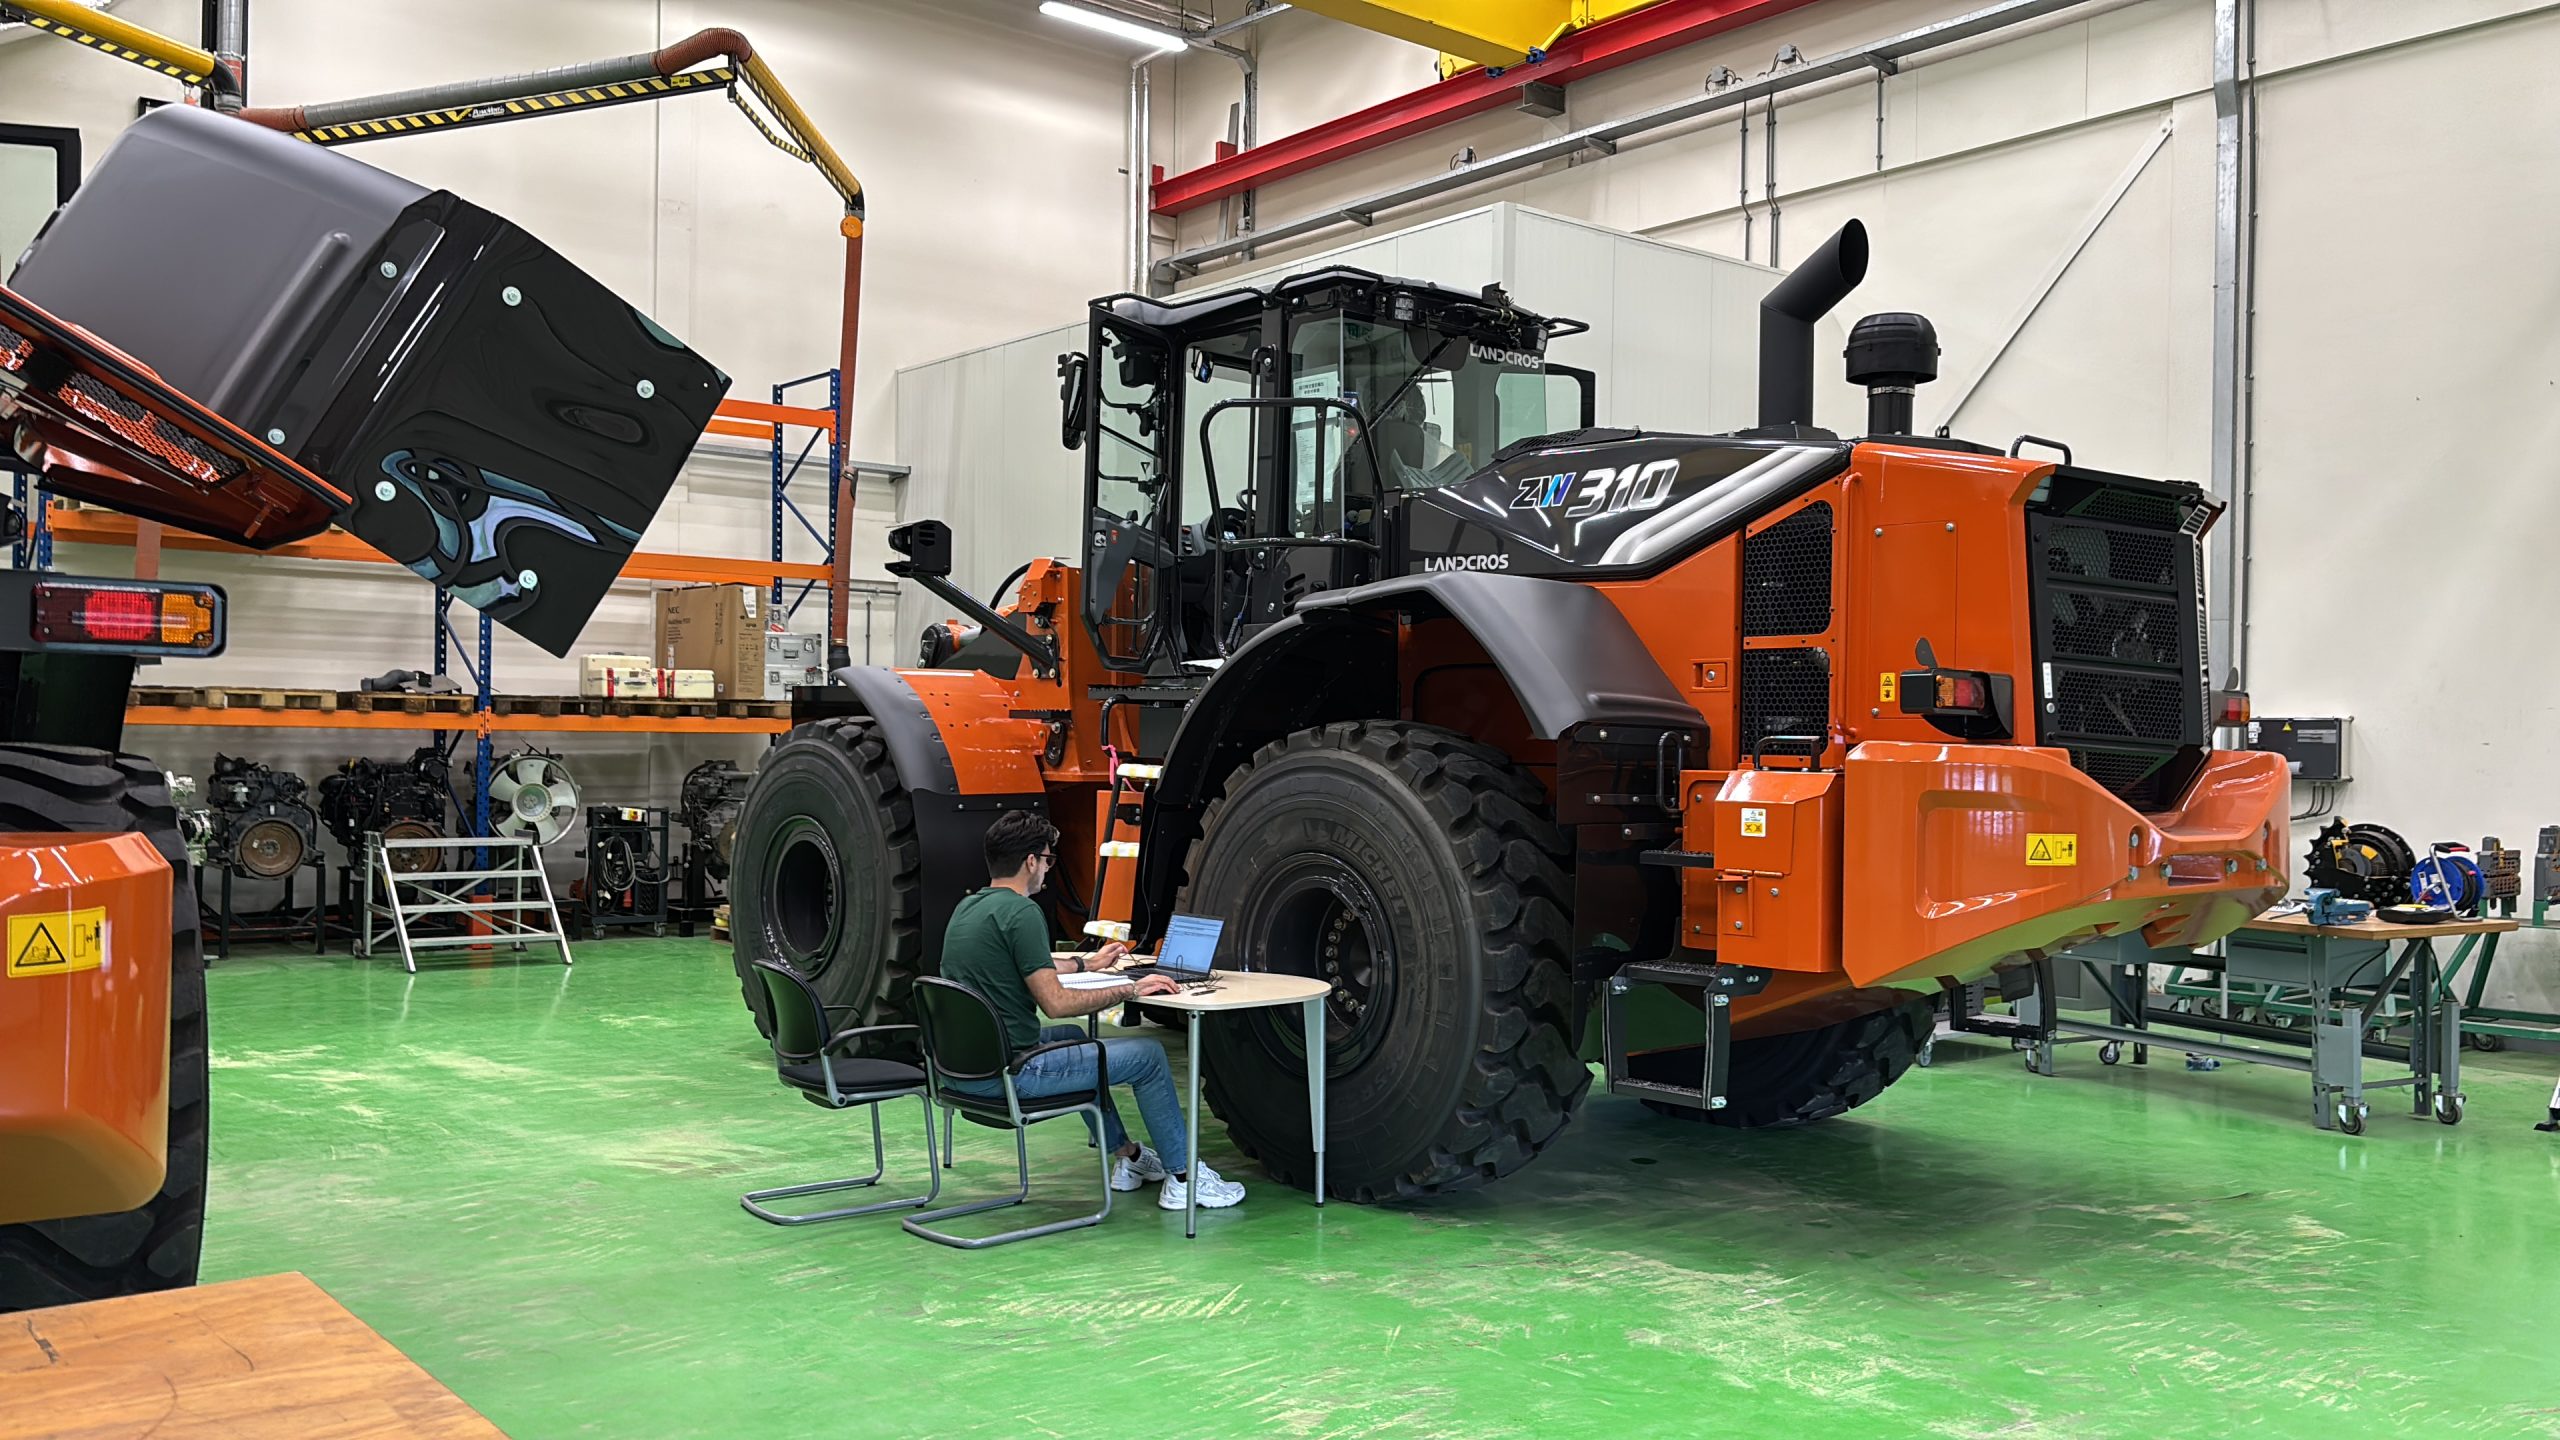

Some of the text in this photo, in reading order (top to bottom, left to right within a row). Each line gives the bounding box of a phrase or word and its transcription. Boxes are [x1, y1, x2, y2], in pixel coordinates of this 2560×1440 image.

[1469, 343, 1539, 369] LANDCROS
[1424, 553, 1509, 572] LANDCROS
[667, 606, 680, 614] NEC
